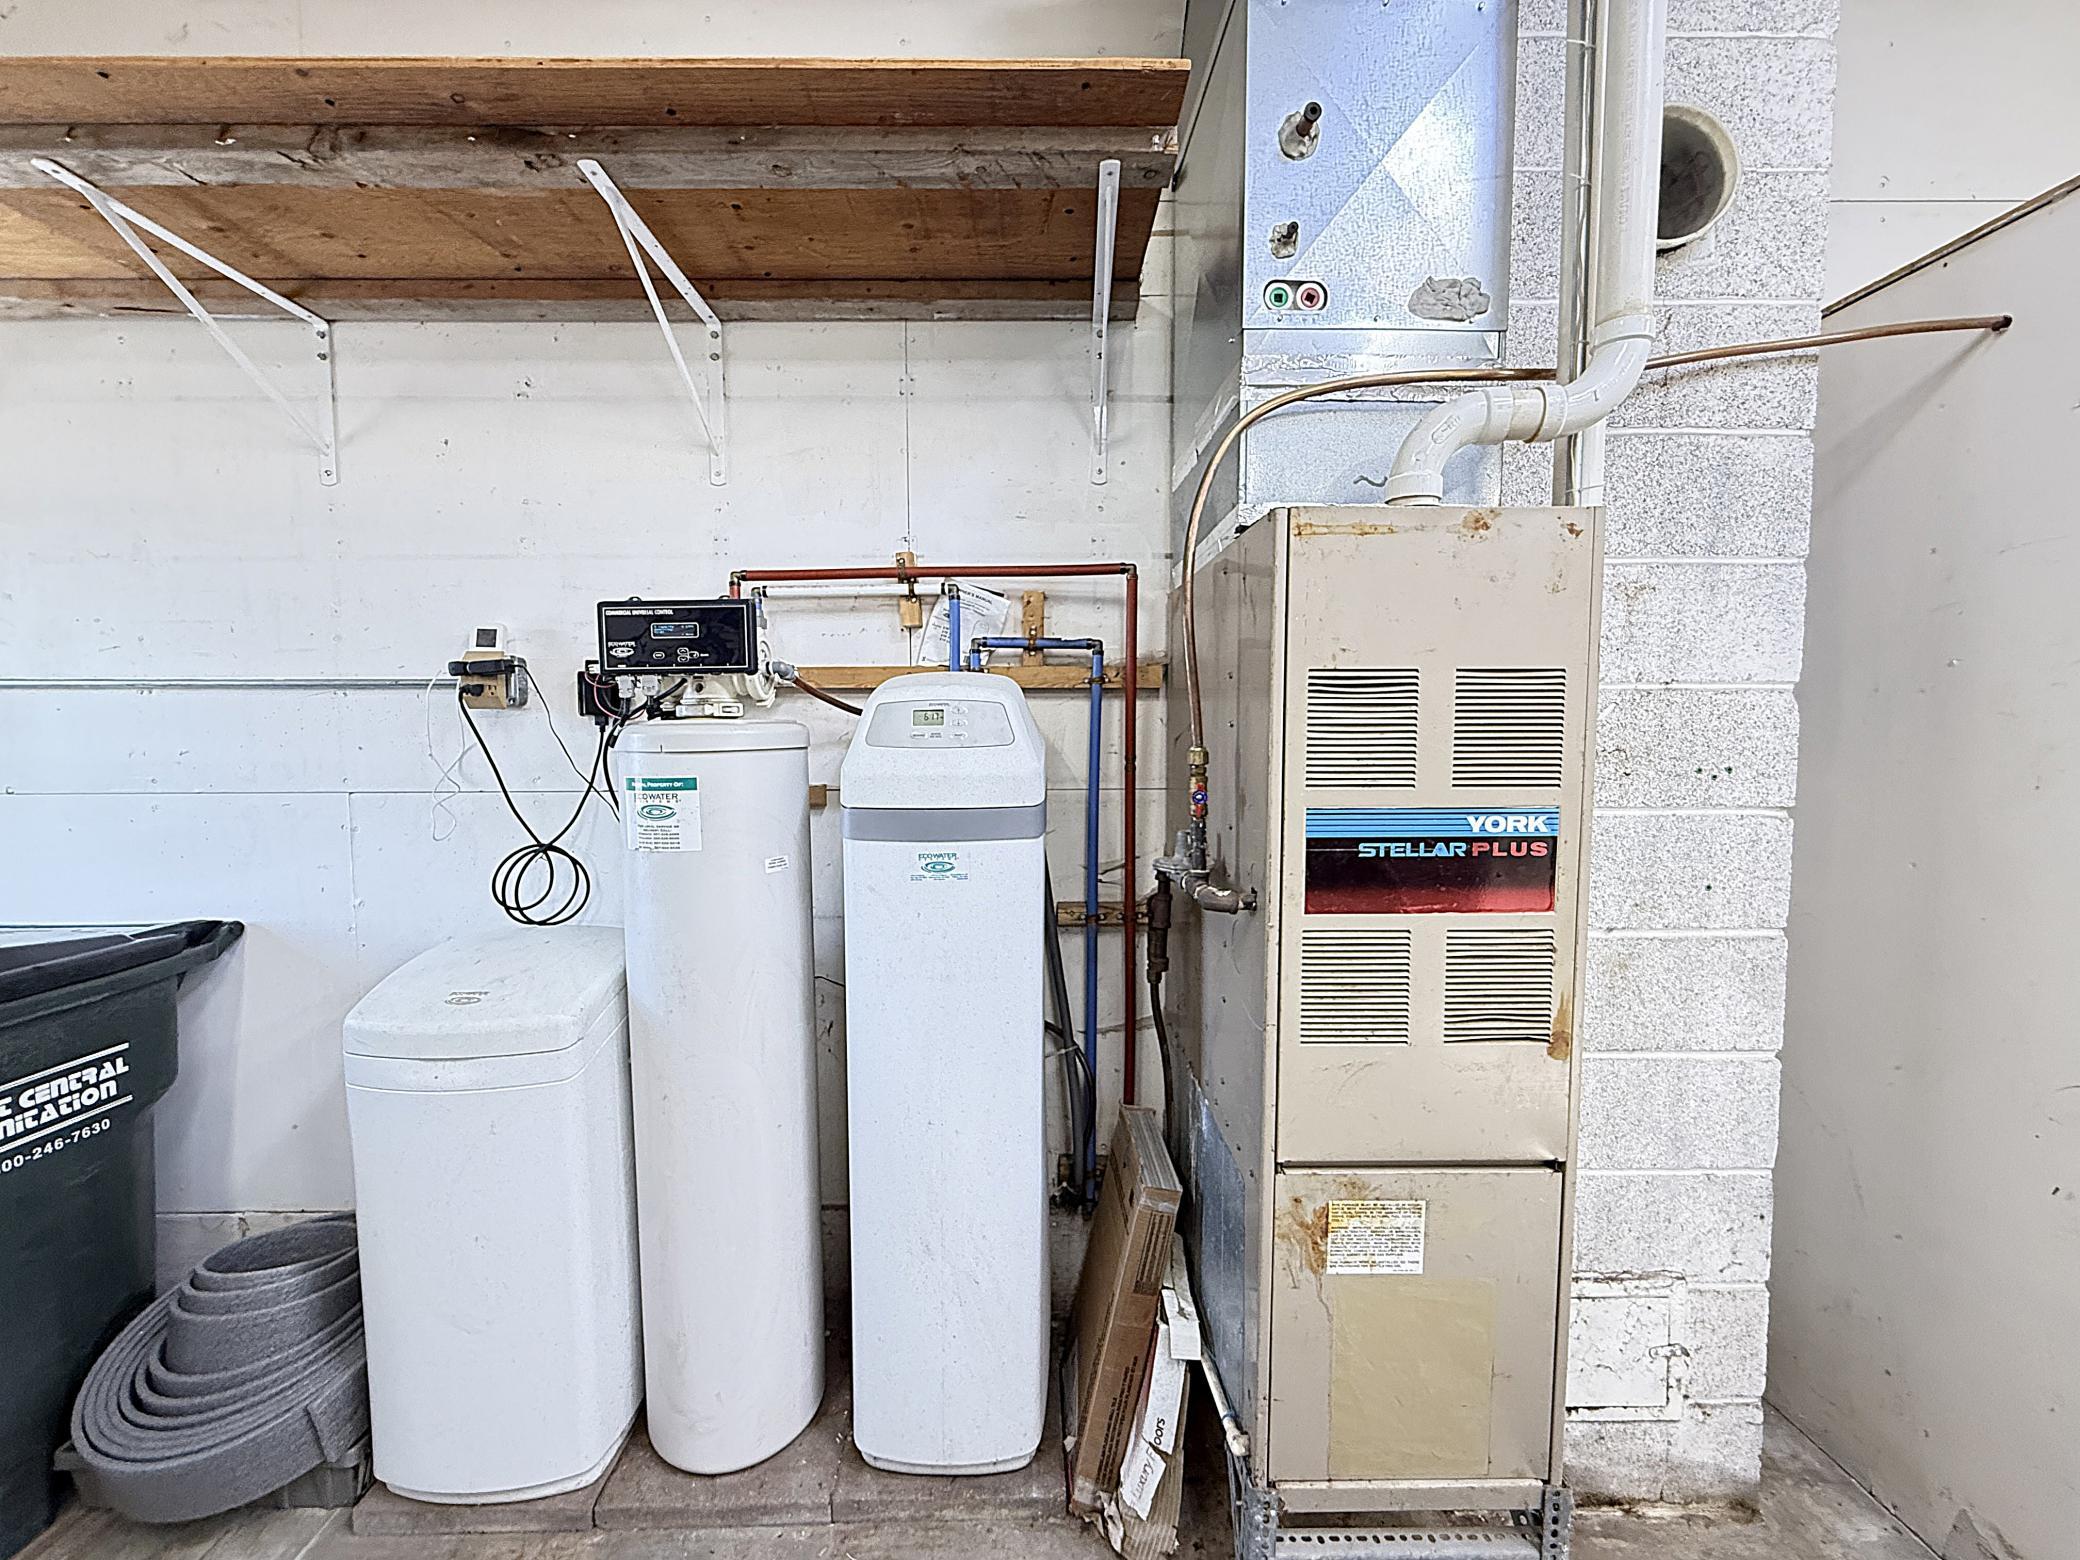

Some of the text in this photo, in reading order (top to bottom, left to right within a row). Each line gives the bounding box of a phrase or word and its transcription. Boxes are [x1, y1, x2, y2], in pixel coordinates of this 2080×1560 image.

[1466, 815, 1550, 833] YORK
[1358, 841, 1549, 858] STELLAR PLUS
[0, 1118, 111, 1174] 00-246-7630
